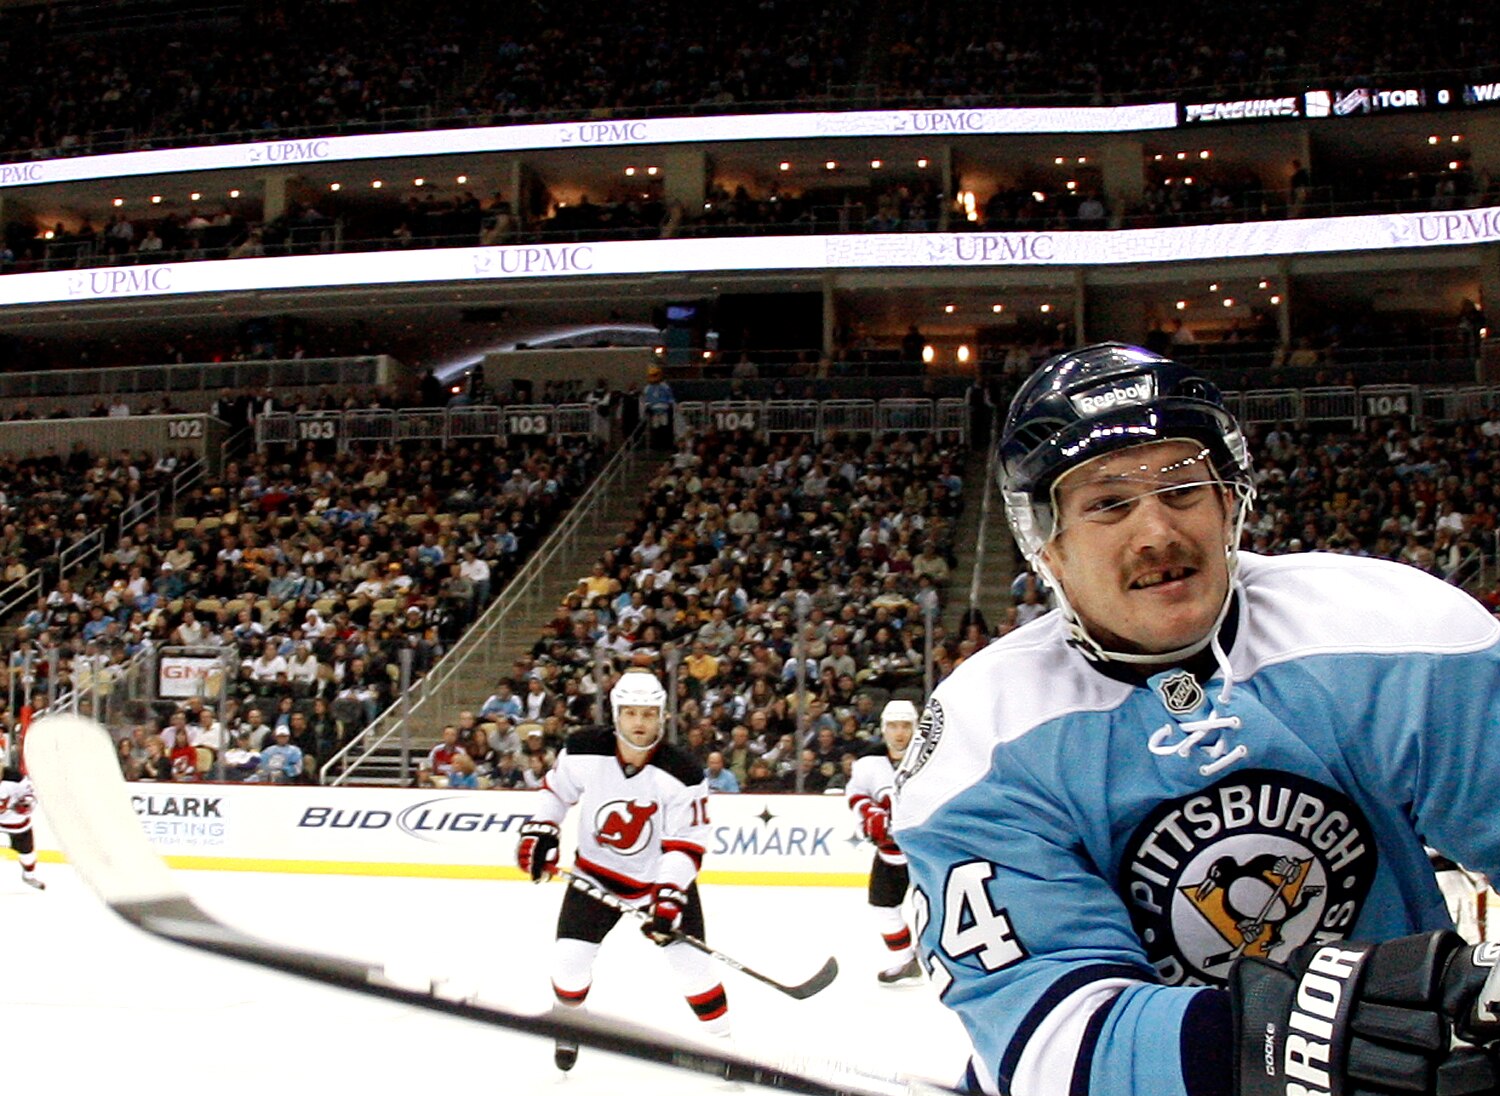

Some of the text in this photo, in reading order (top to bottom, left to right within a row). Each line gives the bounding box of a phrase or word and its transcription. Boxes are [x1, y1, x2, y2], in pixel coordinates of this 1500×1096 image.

[1379, 90, 1420, 107] TOR
[1437, 90, 1450, 104] 0
[912, 111, 983, 131] UPMC
[578, 123, 648, 143] UPMC
[266, 141, 330, 161] UPMC
[954, 234, 1054, 261] UPMC
[499, 246, 593, 274] UPMC
[90, 267, 172, 295] UPMC
[1081, 379, 1150, 413] Reebok
[1366, 395, 1407, 415] 104
[169, 420, 202, 438] 102
[300, 421, 335, 439] 103
[510, 415, 547, 434] 103
[715, 410, 755, 431] 104
[131, 795, 223, 817] CLARK
[297, 807, 392, 829] BUD
[712, 826, 834, 856] SMARK
[1131, 784, 1366, 915] PITTSBURGH
[1265, 1022, 1275, 1077] COOKE
